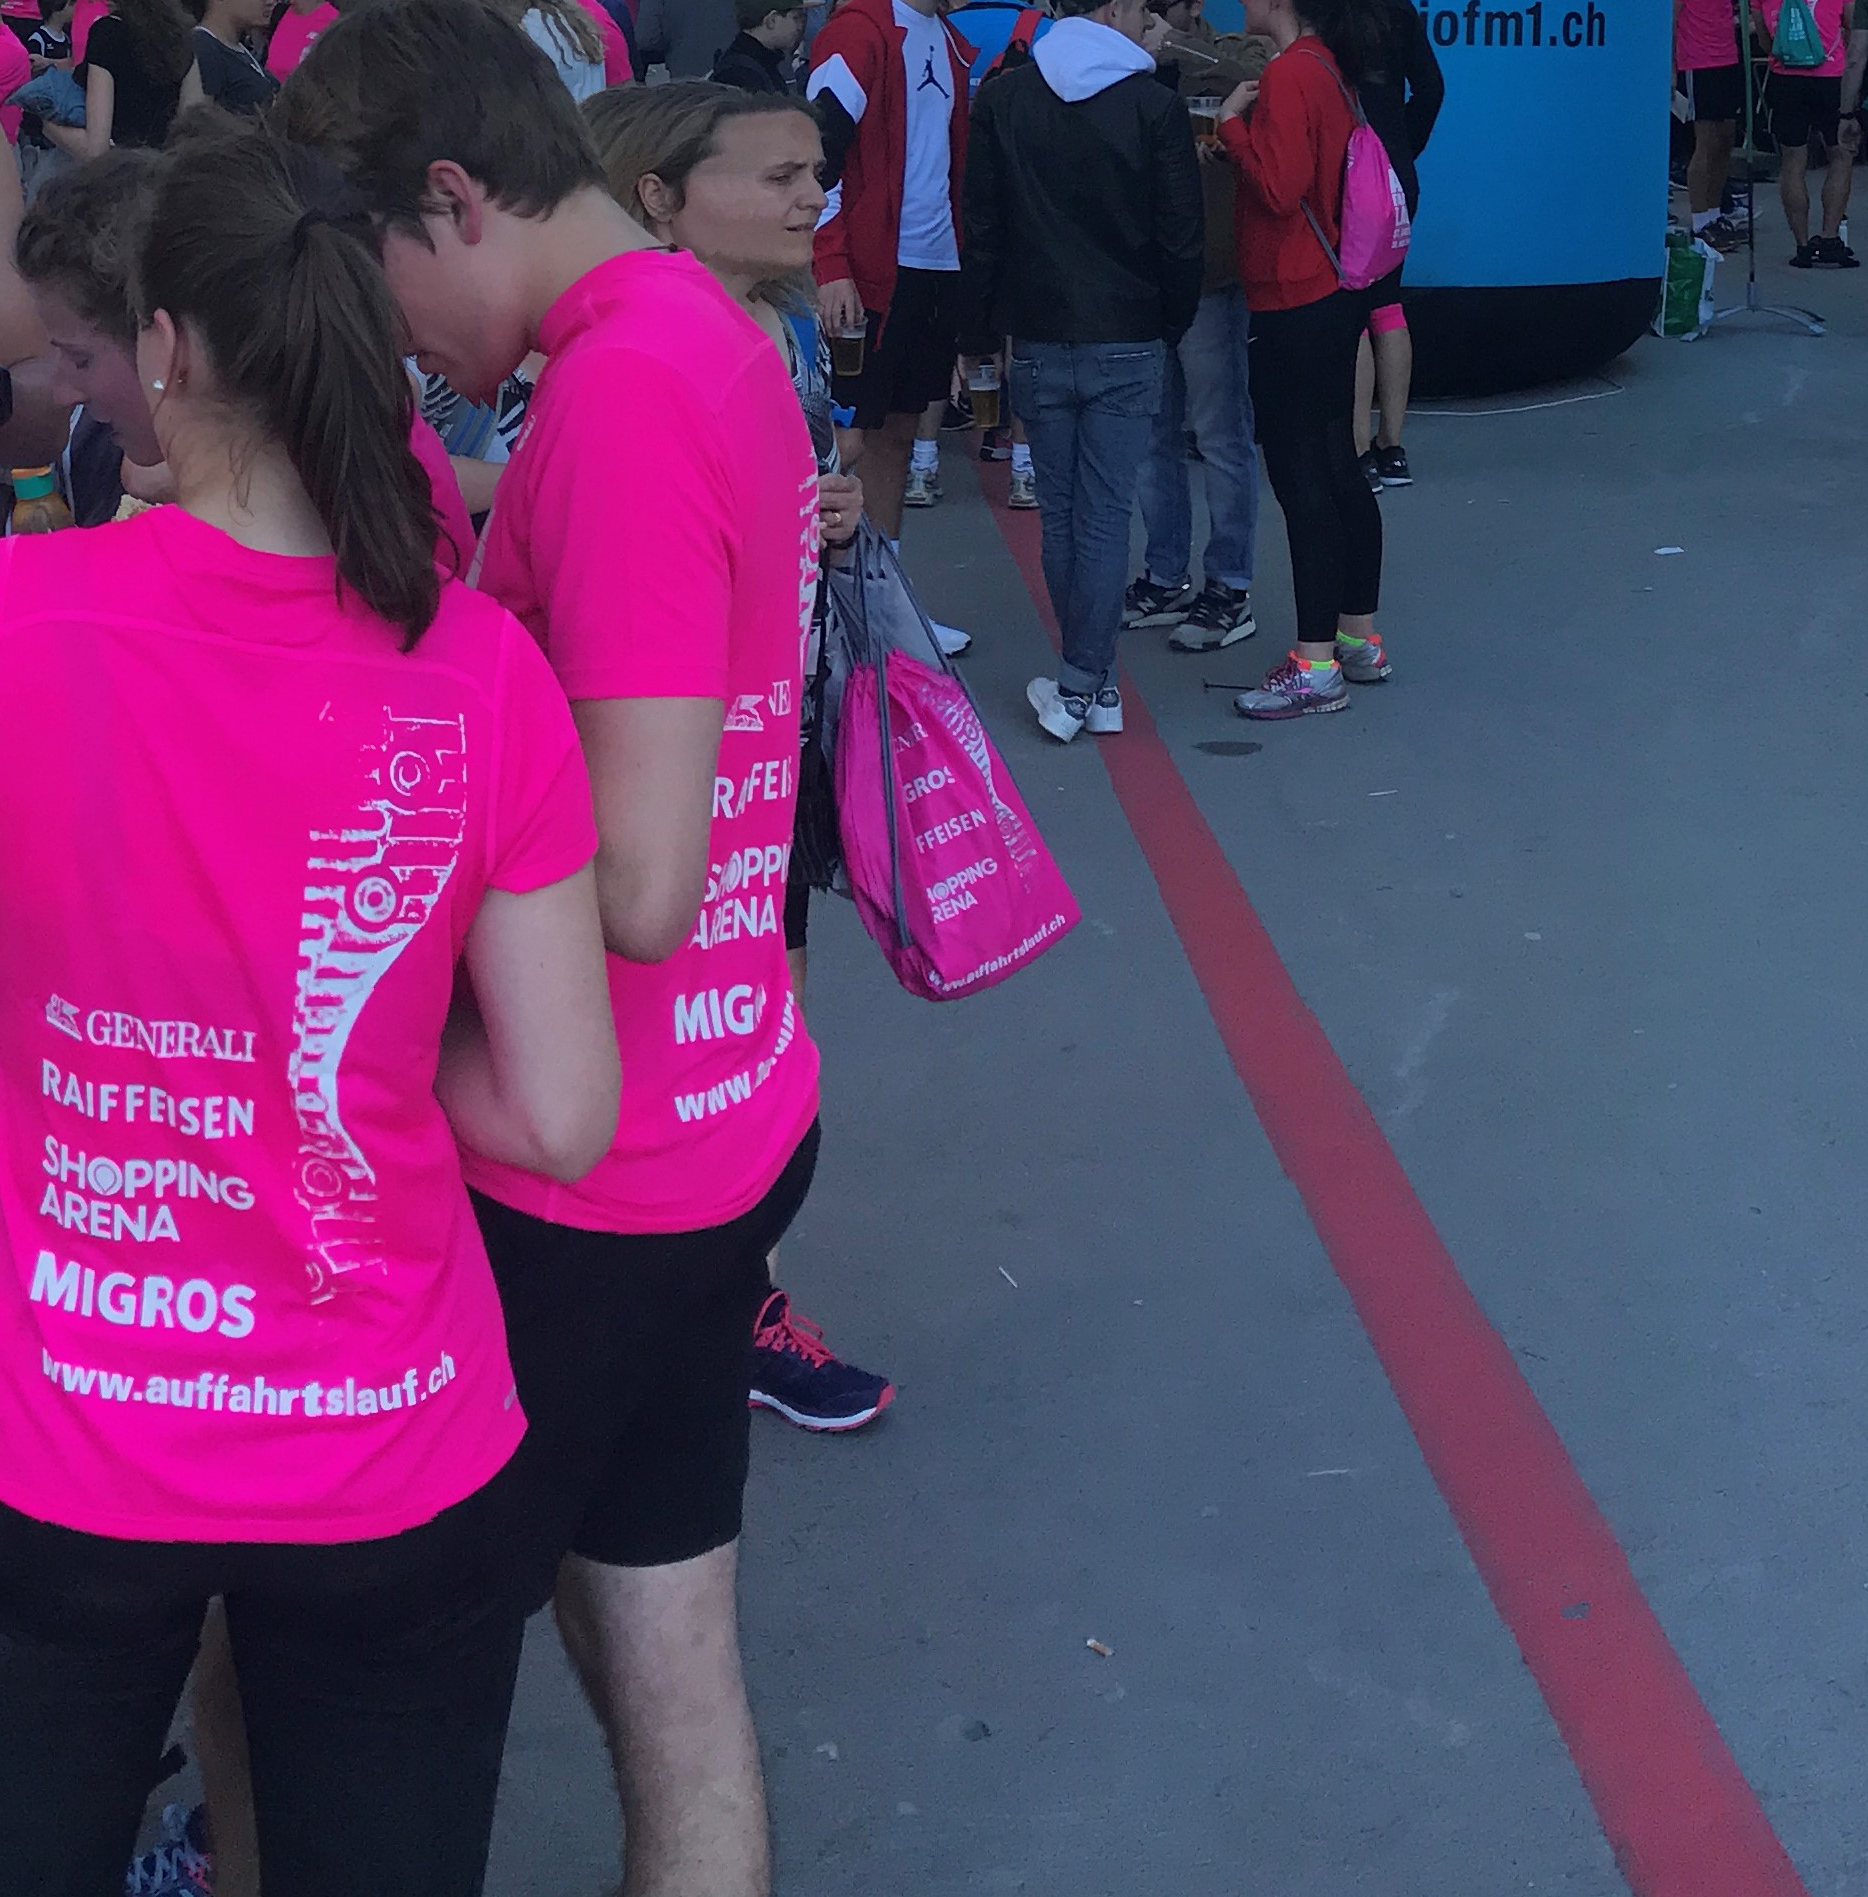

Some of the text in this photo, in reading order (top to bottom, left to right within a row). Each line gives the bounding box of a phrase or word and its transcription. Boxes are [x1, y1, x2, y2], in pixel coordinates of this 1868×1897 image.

[1417, 0, 1606, 48] iofm1.ch
[902, 766, 957, 805] GROS
[915, 807, 987, 855] FFEISEN
[932, 889, 979, 926] RENA
[85, 1008, 257, 1064] GENERALI
[40, 1057, 256, 1138] RAIFFEISEN
[41, 1134, 256, 1212] SHOPPING
[38, 1190, 182, 1244] ARENA
[28, 1249, 258, 1340] MIGROS
[40, 1348, 457, 1418] www.auffahrtslauf.ch
